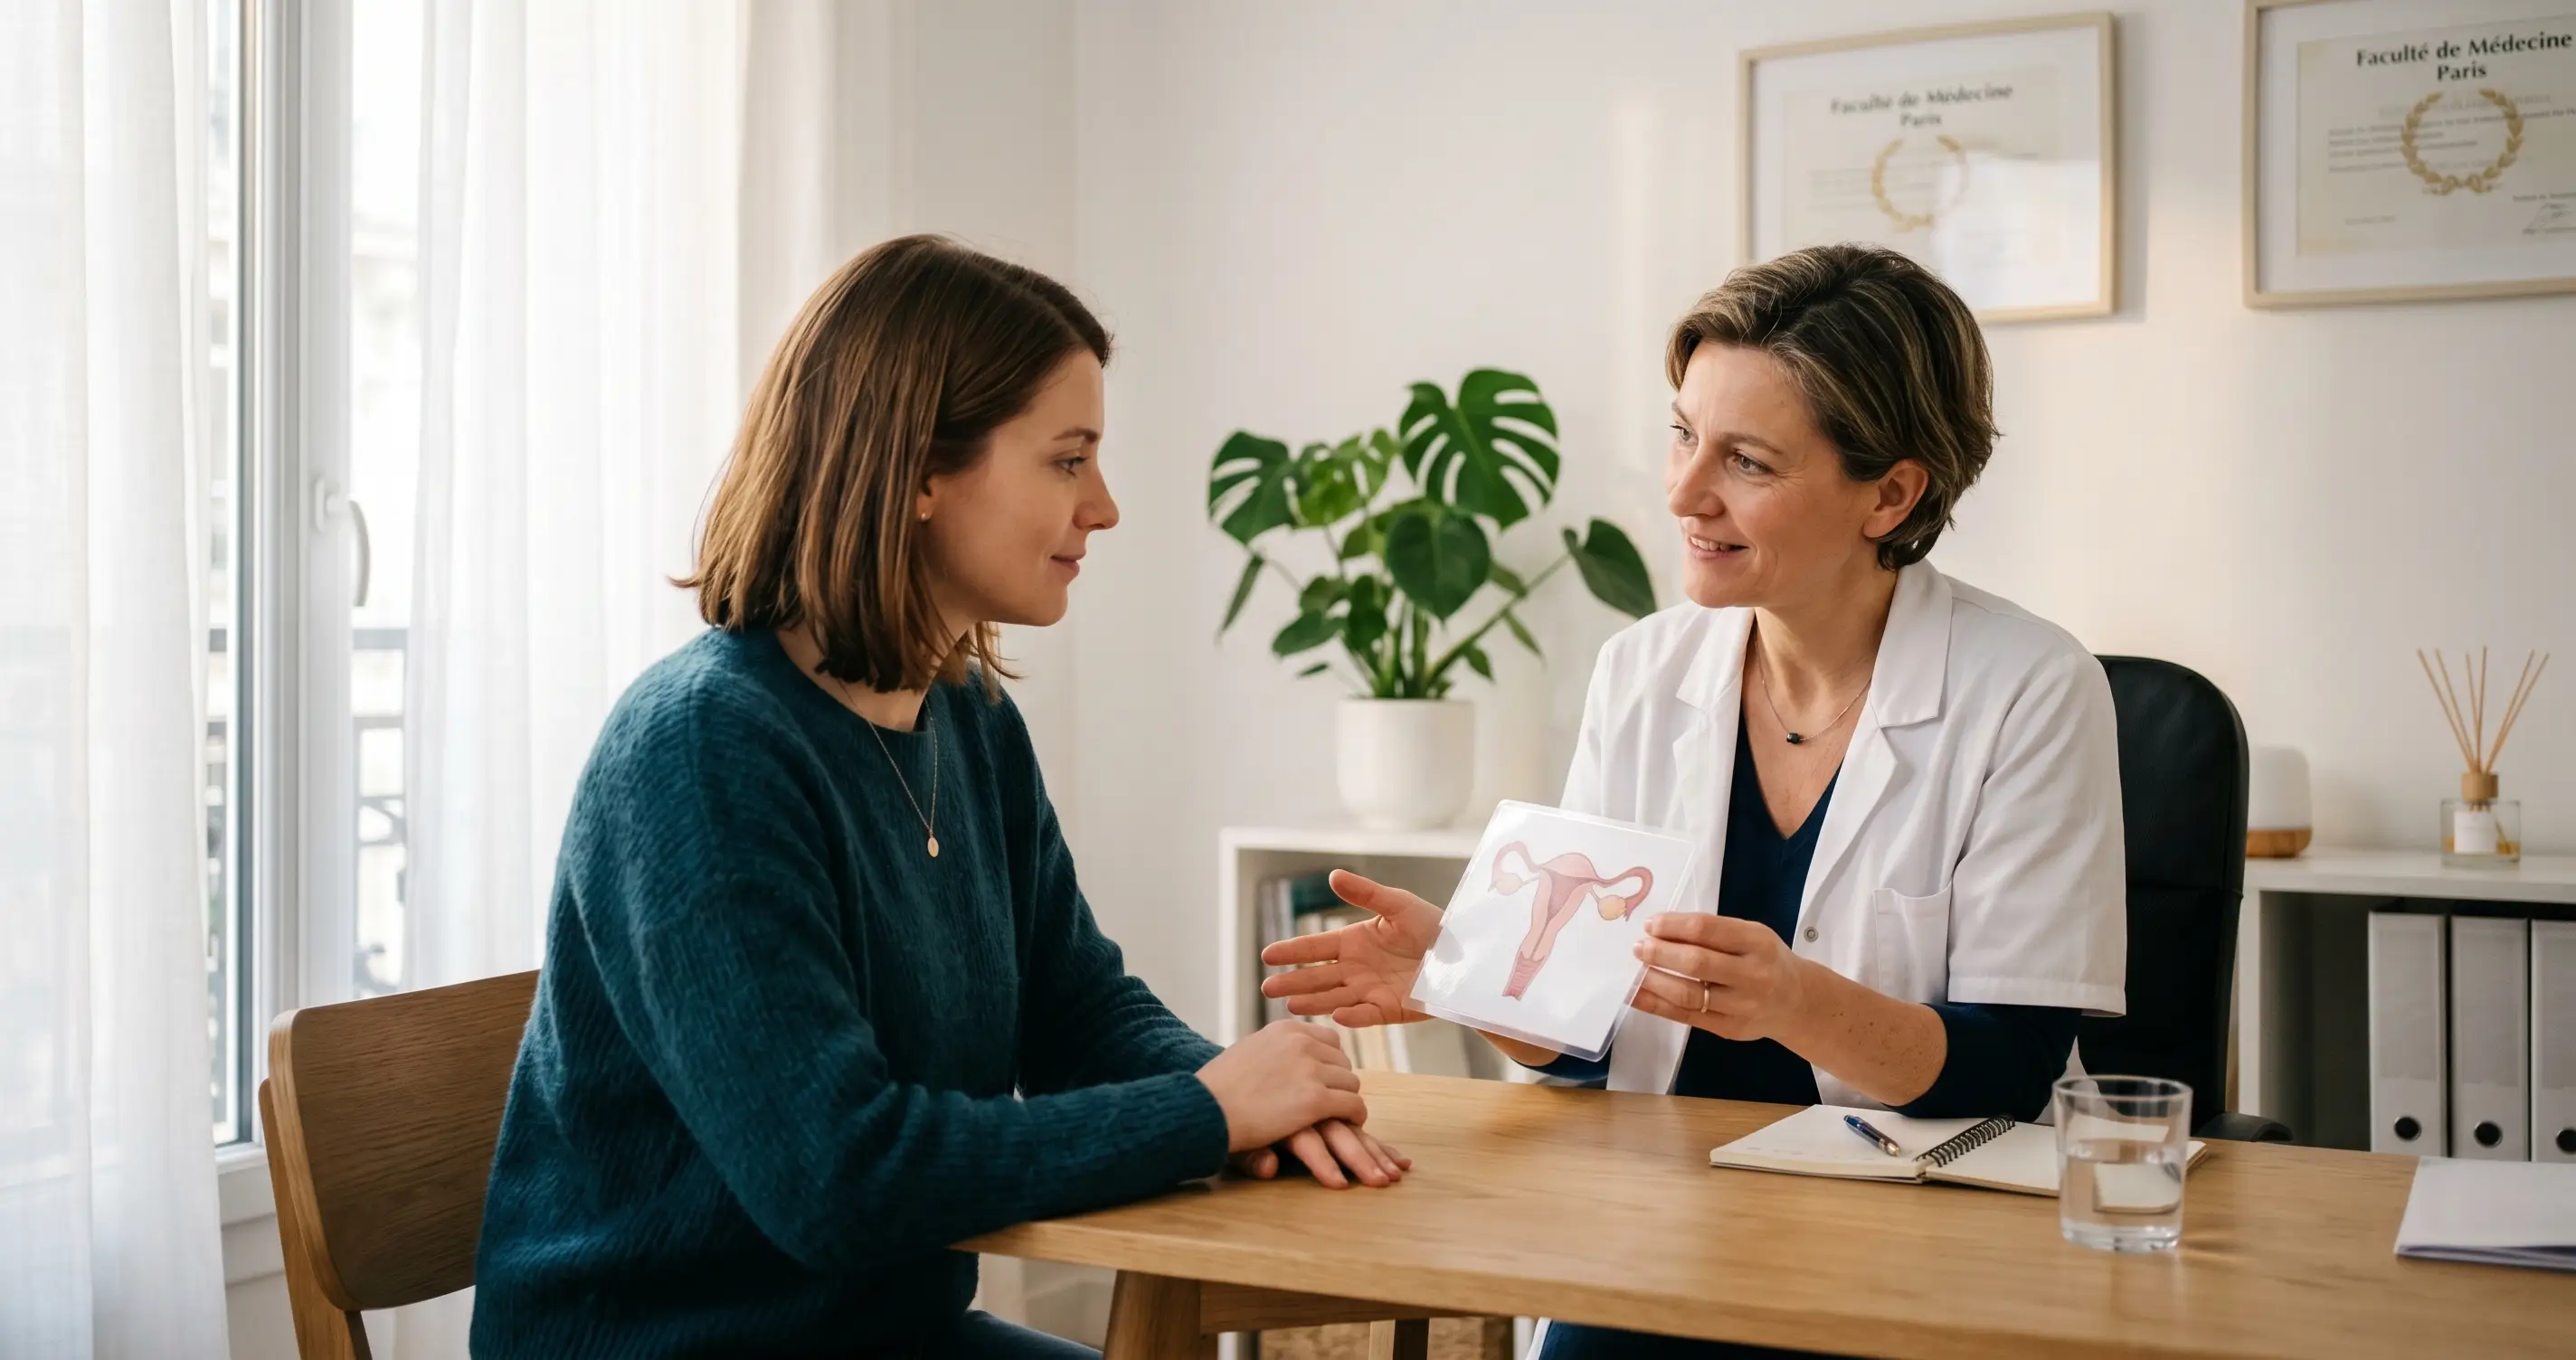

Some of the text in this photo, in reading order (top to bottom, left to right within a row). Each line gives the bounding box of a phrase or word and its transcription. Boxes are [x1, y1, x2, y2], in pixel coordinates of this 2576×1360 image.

[2356, 32, 2572, 67] Faculté de Médecine
[2437, 61, 2487, 82] Paris
